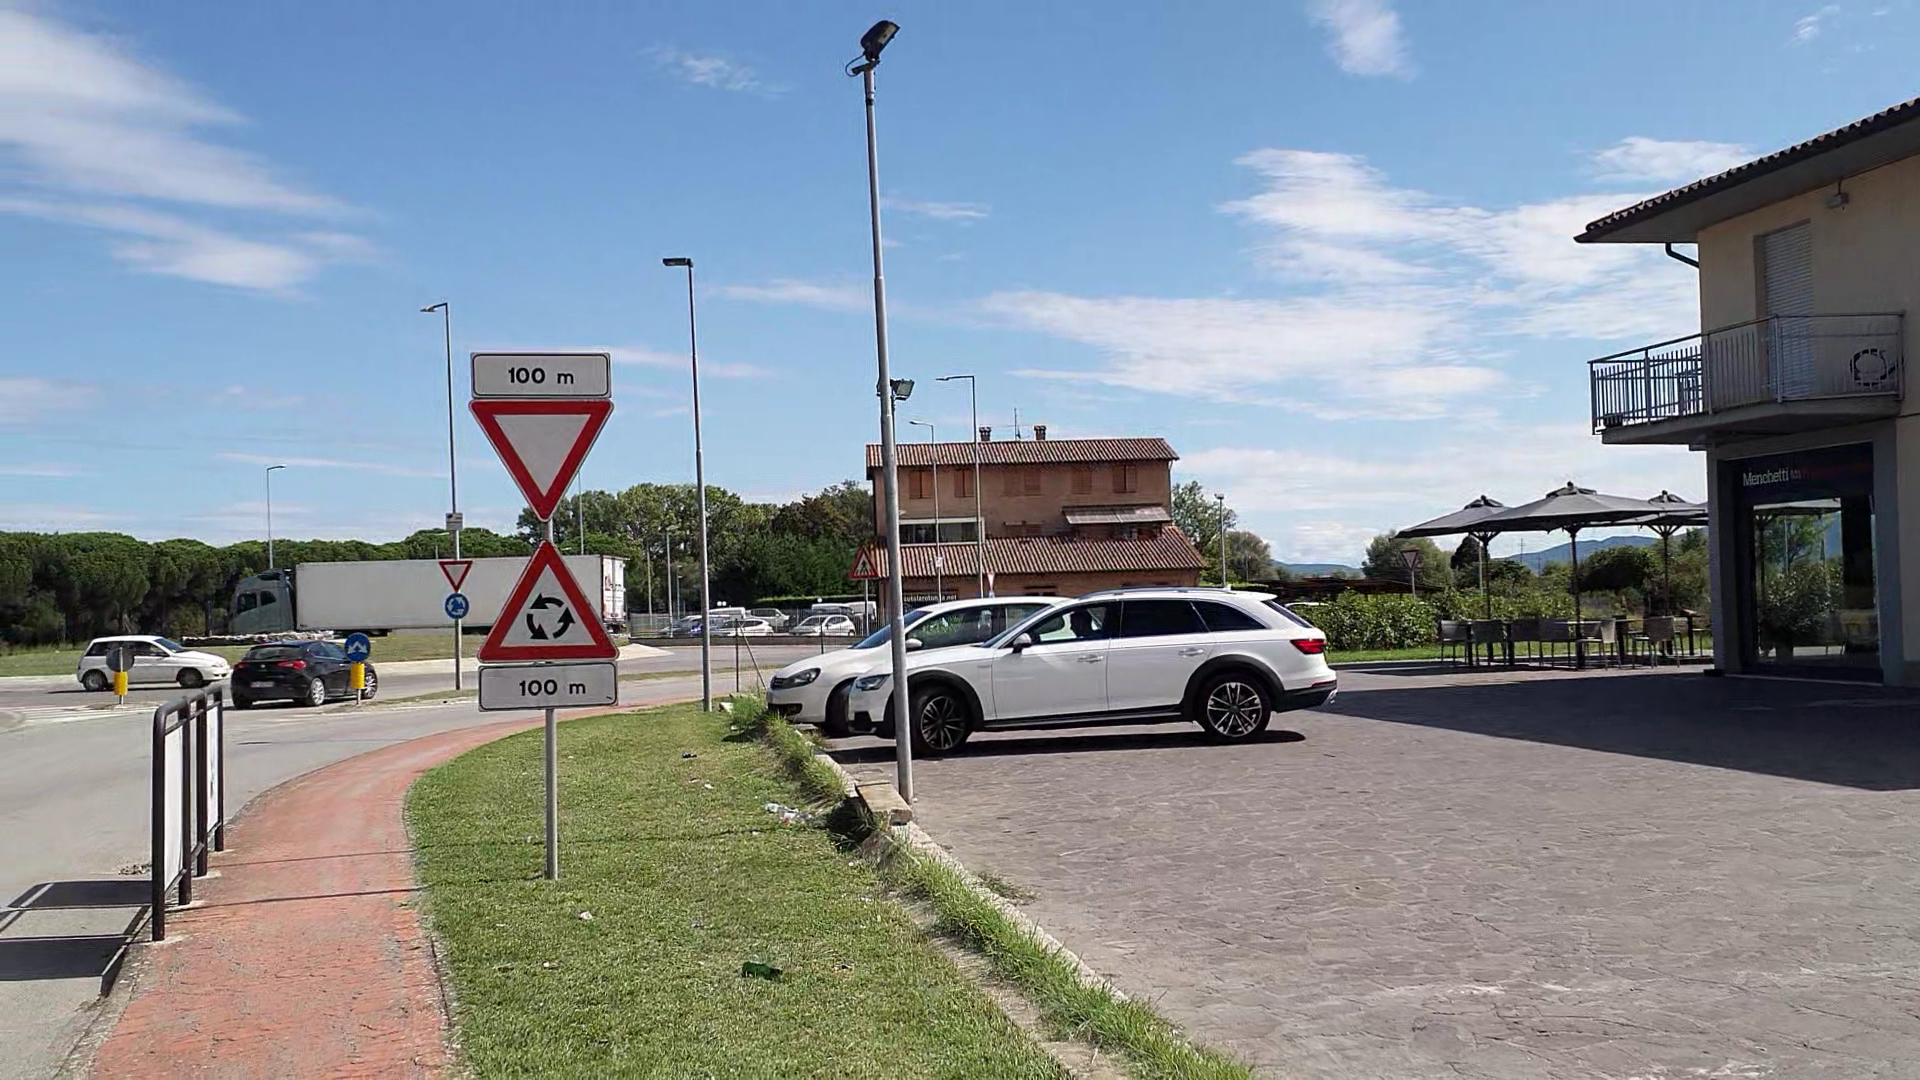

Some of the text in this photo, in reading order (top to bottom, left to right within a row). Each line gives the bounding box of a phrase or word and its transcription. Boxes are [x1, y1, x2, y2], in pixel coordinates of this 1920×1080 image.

[507, 366, 574, 384] 100 m
[1742, 467, 1789, 486] Menchetti
[904, 594, 957, 602] autolarotona.net
[518, 678, 586, 697] 100 m
